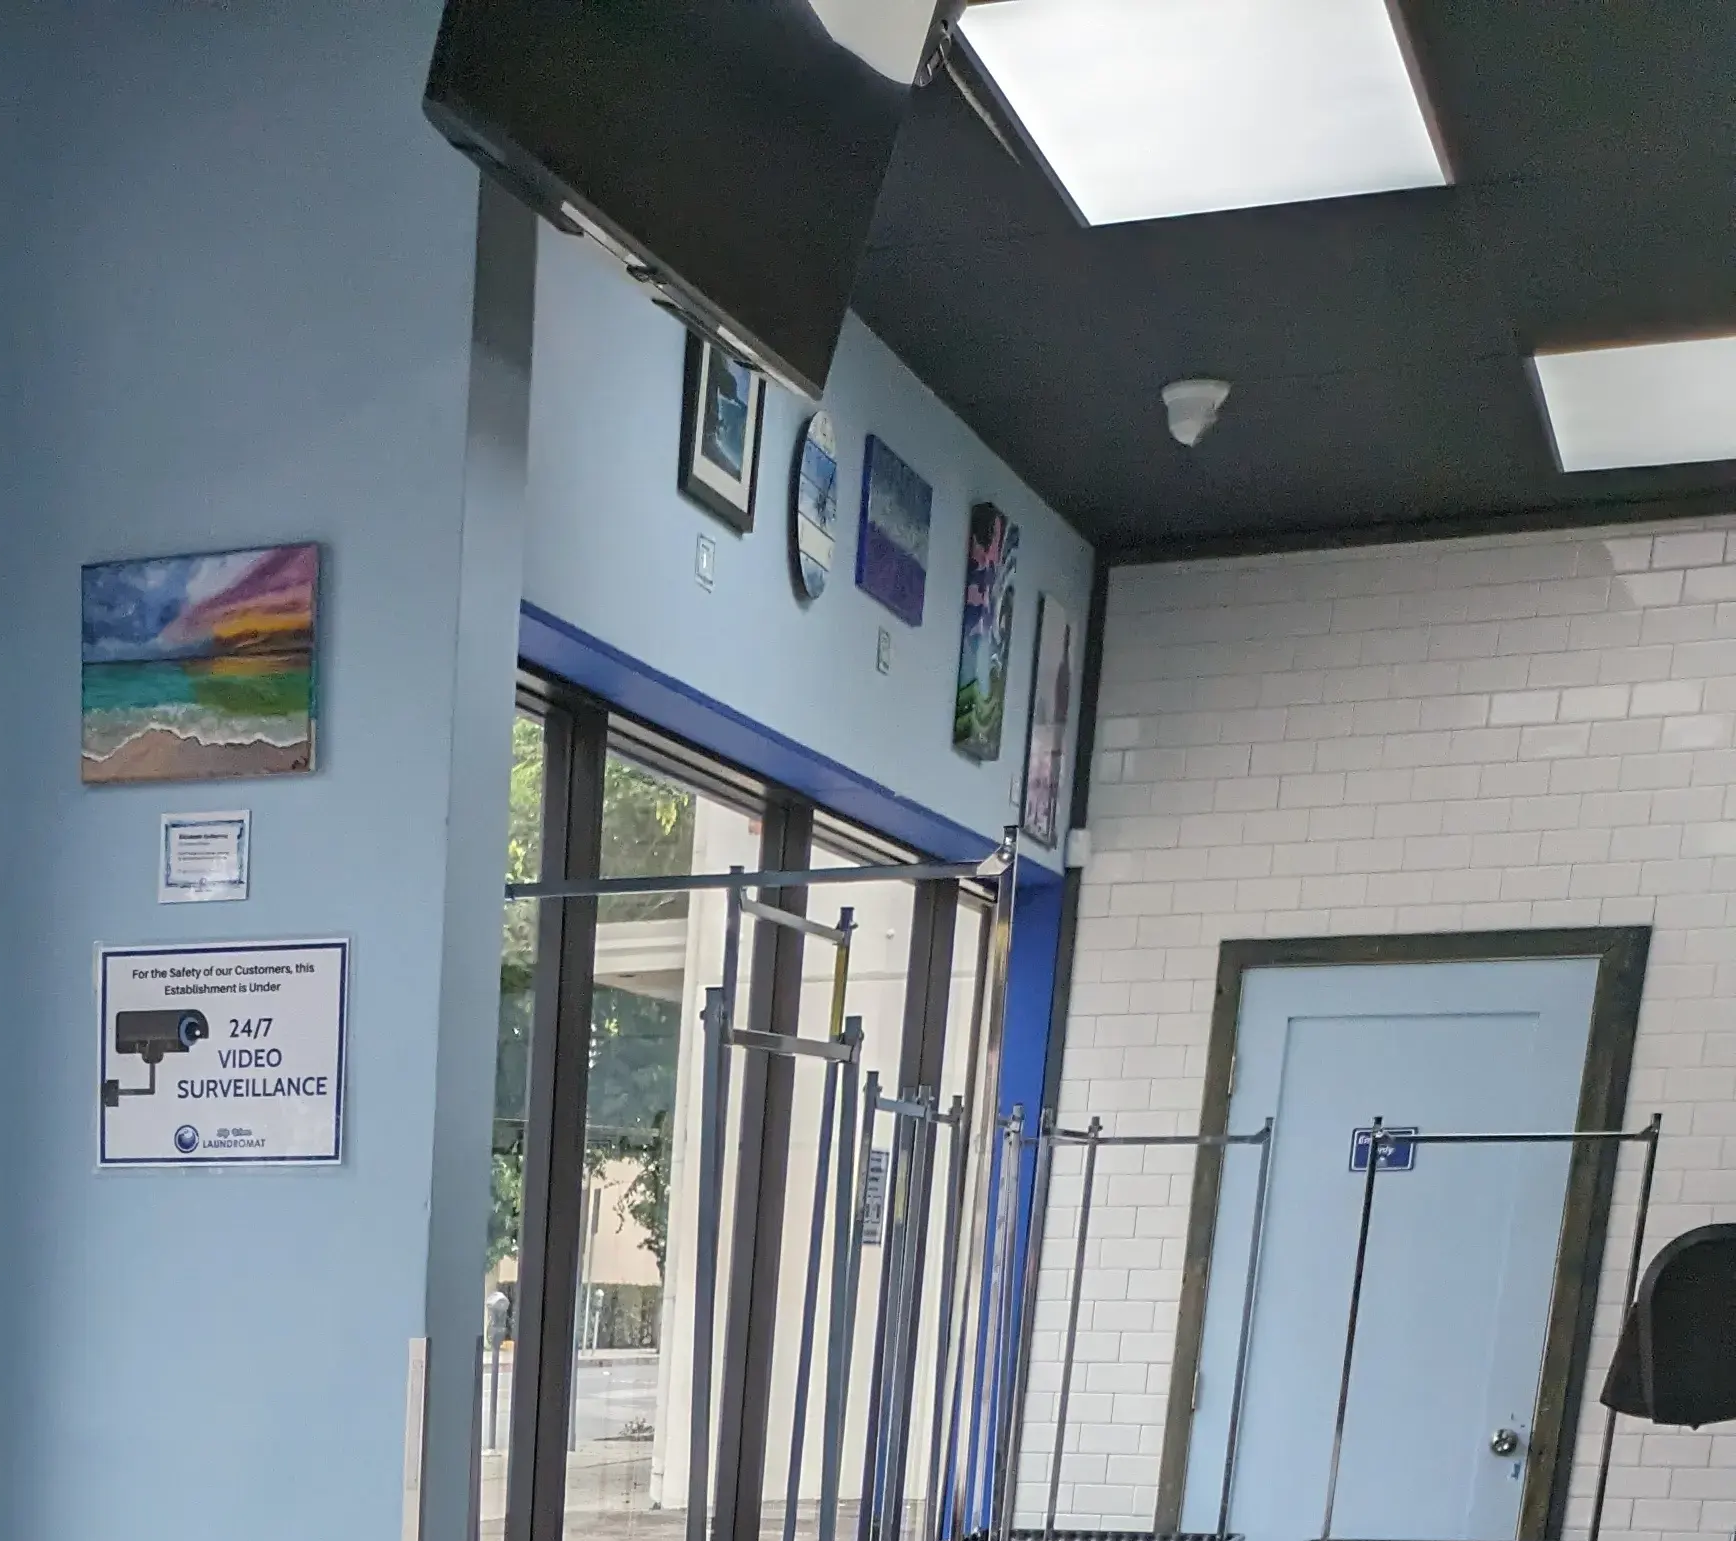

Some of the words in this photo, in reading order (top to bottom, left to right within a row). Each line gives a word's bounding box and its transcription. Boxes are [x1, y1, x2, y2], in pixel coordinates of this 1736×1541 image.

[132, 969, 149, 979] For
[150, 968, 167, 979] the
[169, 966, 201, 980] Safety
[203, 966, 214, 977] of
[215, 967, 233, 977] our
[235, 964, 293, 976] Customers,
[295, 963, 315, 973] this
[164, 984, 237, 995] Establishment
[238, 983, 247, 993] is
[249, 982, 282, 993] Under
[229, 1018, 273, 1039] 24/7
[218, 1048, 282, 1068] VIDEO
[177, 1076, 328, 1098] SURVEILLANCE
[202, 1139, 266, 1149] LAUNDROMAT
